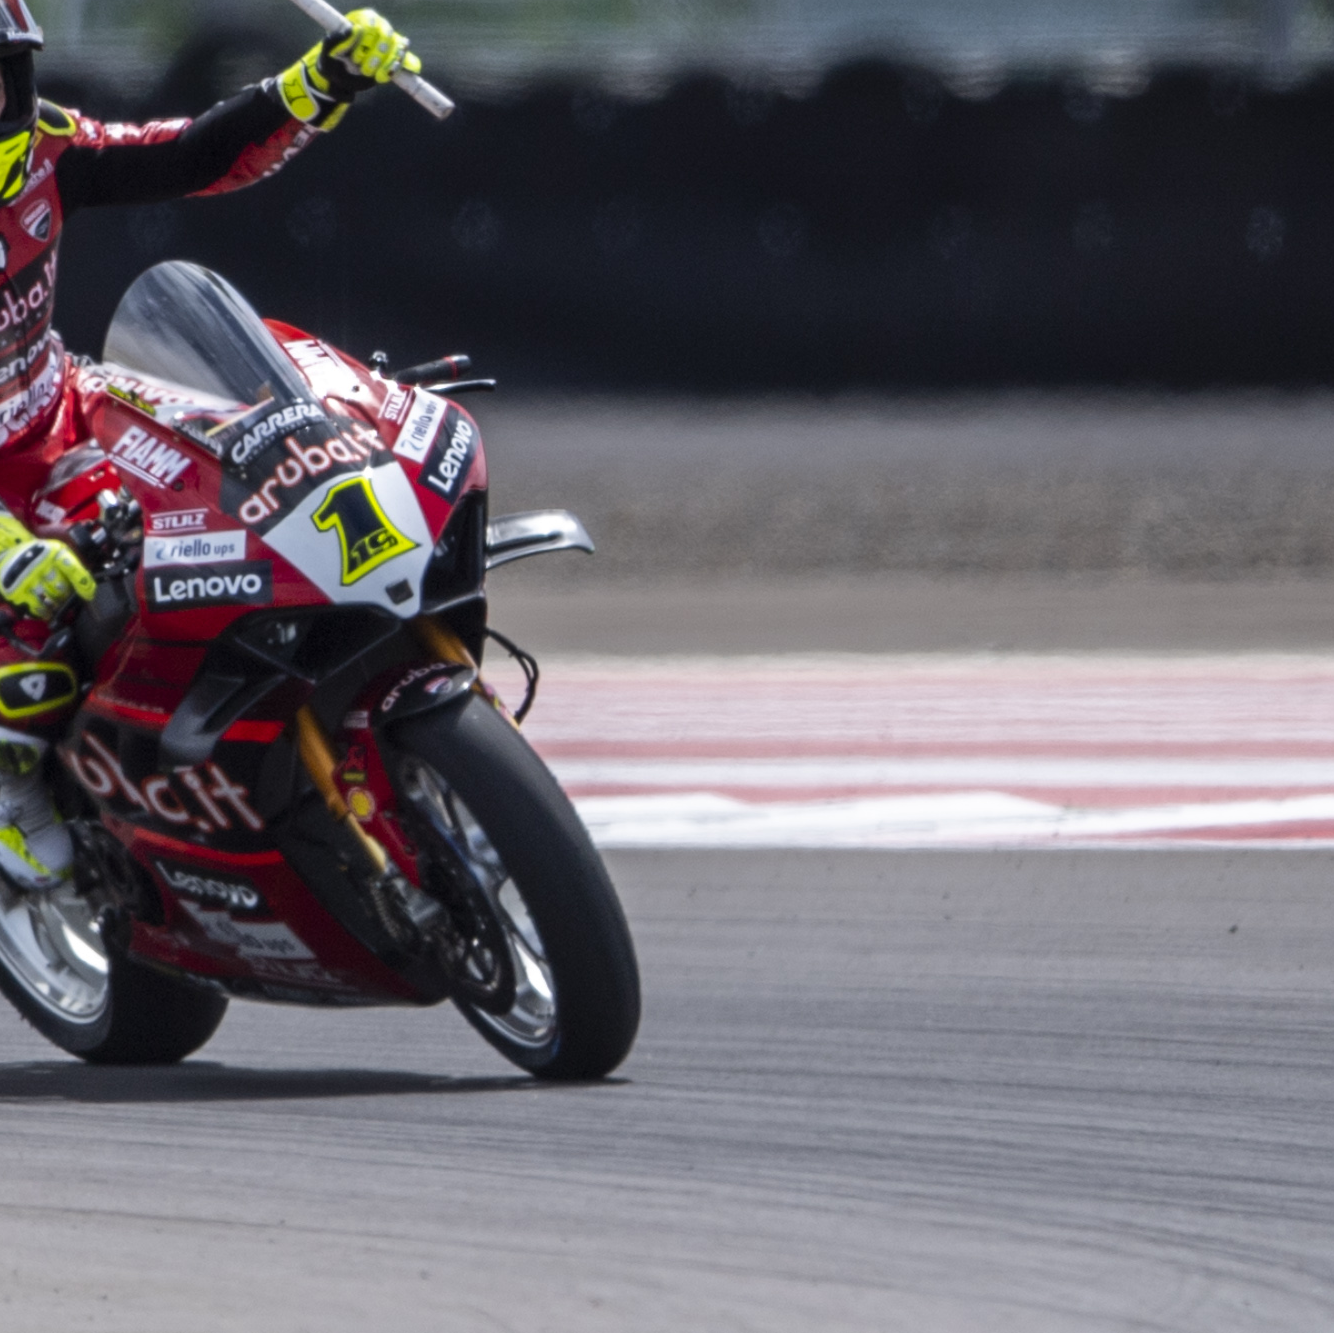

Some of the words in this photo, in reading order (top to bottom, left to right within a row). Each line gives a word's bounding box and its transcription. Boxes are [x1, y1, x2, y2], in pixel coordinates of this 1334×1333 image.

[111, 425, 192, 486] FIAMM
[231, 403, 325, 465] CARRERA
[427, 420, 474, 494] Lenovo
[239, 422, 386, 524] aruba.it
[171, 539, 211, 557] riello
[213, 543, 235, 557] ups
[310, 475, 422, 587] 1
[154, 573, 263, 603] Lenovo
